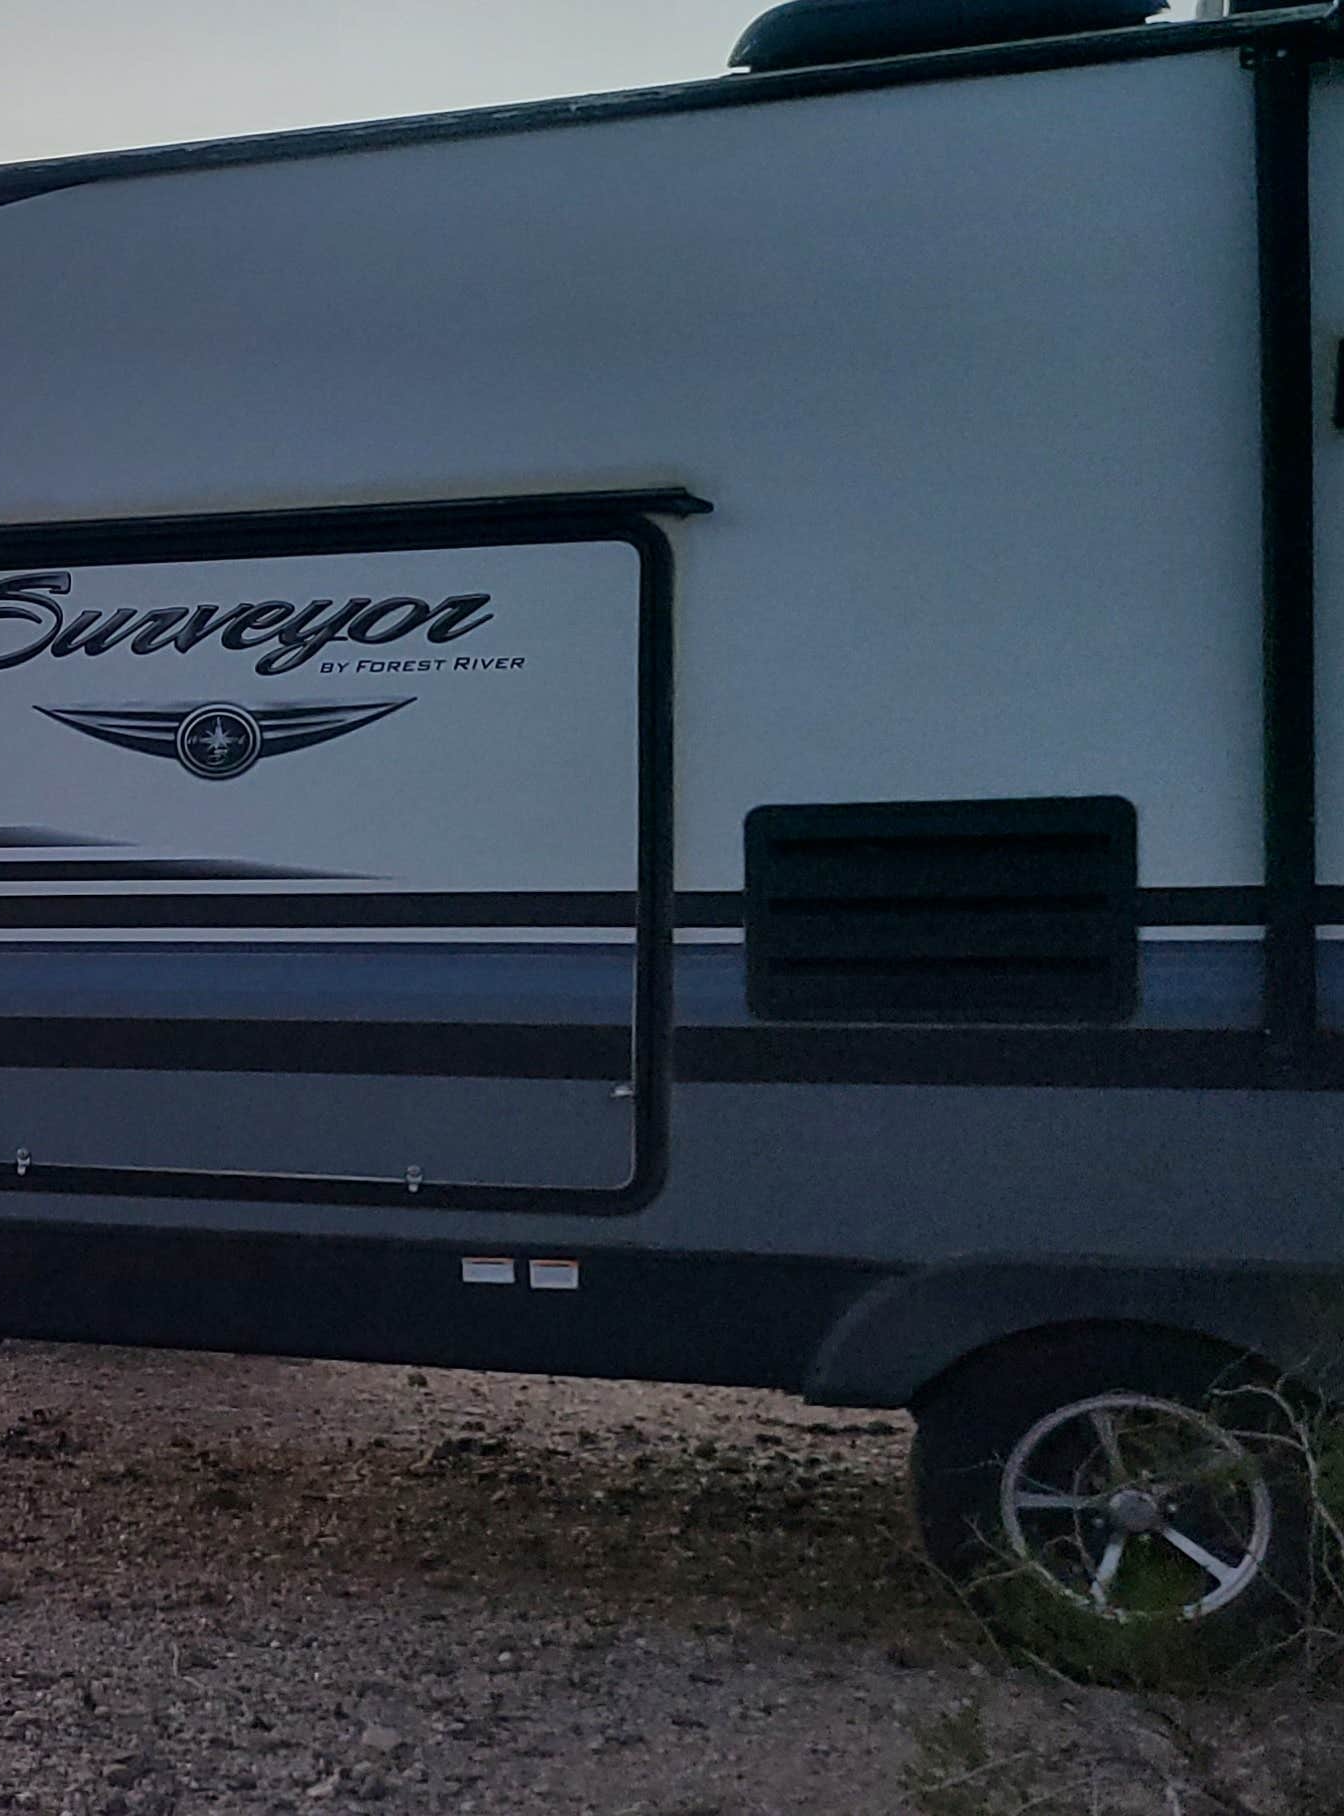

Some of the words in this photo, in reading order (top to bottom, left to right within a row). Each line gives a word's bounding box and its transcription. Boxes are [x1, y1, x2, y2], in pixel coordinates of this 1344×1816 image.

[320, 662, 349, 674] BY
[356, 659, 447, 673] FOREST
[454, 657, 526, 671] RIVER
